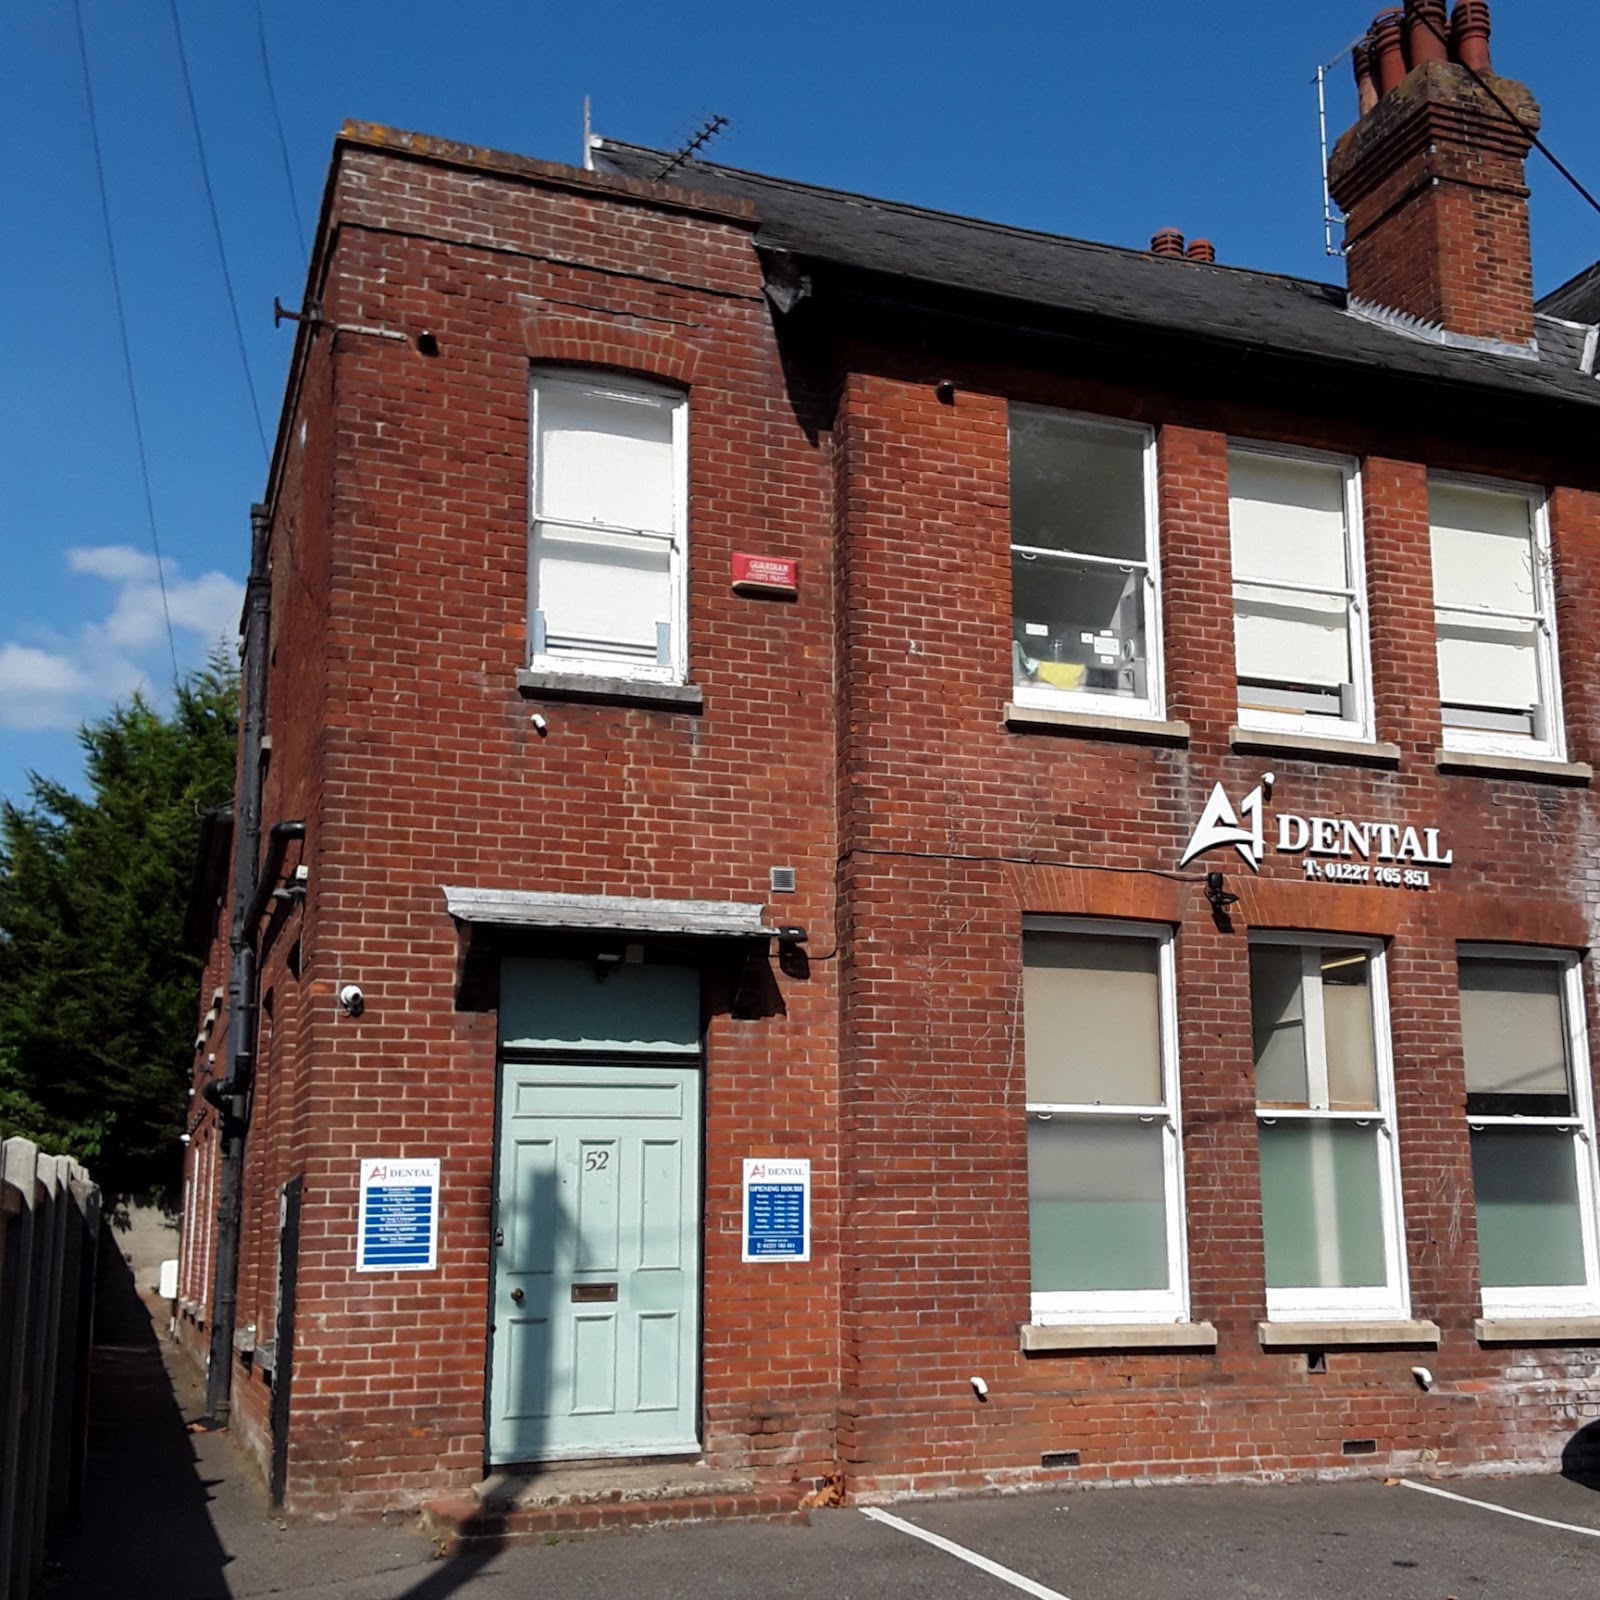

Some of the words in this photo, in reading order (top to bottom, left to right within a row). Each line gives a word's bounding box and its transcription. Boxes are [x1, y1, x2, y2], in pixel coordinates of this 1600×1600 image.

[1275, 813, 1453, 865] DENTAL
[1303, 859, 1322, 878] T:
[1325, 862, 1369, 881] 01227
[1373, 866, 1402, 884] 765
[1404, 869, 1431, 888] 851
[585, 1150, 609, 1172] 52
[768, 1168, 804, 1176] DENTAL
[390, 1169, 432, 1177] DENTAL
